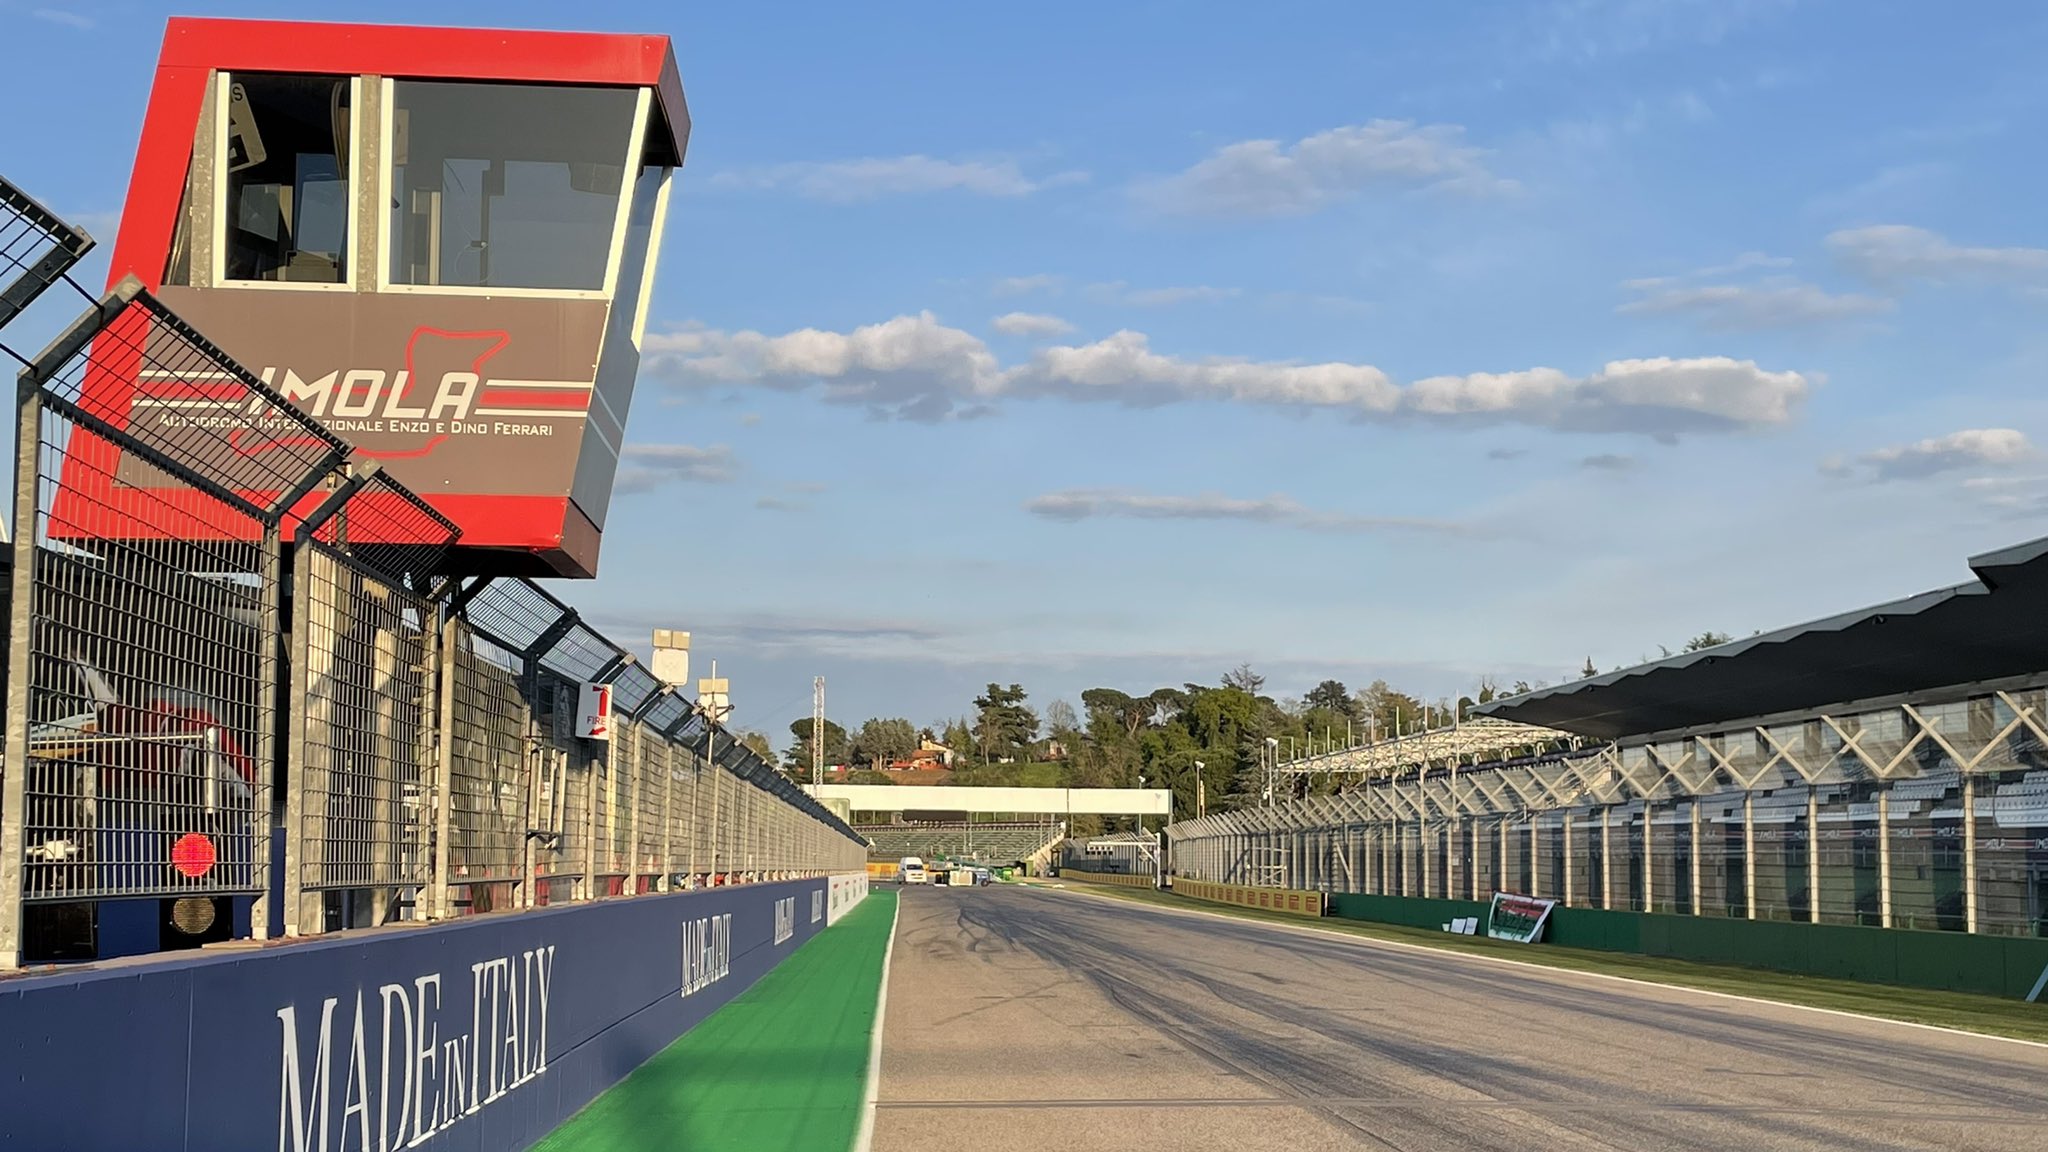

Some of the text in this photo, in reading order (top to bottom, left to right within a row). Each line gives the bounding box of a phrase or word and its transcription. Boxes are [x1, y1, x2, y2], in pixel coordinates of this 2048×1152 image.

[247, 366, 480, 420] IMOLA
[389, 419, 430, 433] ENZO
[435, 422, 445, 434] E
[450, 421, 488, 435] DINO
[494, 422, 553, 436] FERRARI
[586, 715, 607, 726] FIRE
[277, 973, 441, 1152] MADE
[465, 945, 555, 1115] ITALY
